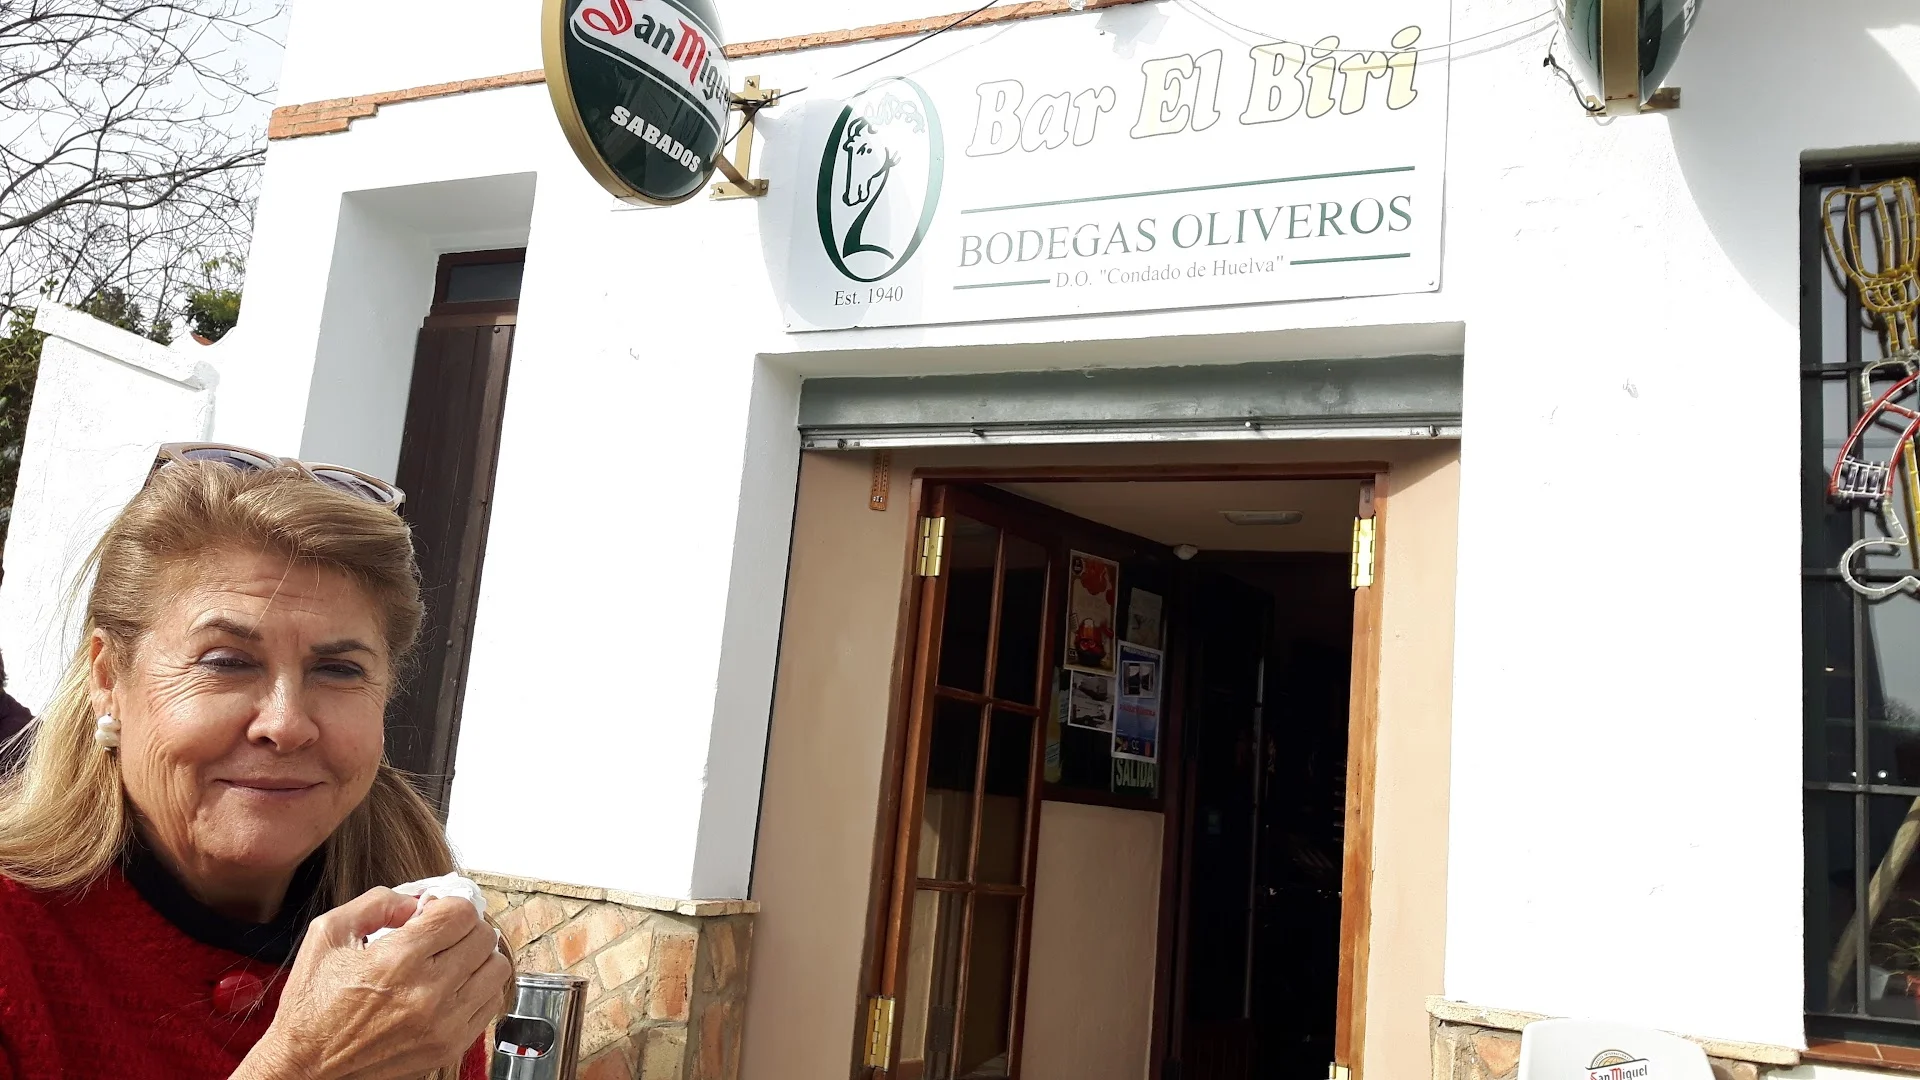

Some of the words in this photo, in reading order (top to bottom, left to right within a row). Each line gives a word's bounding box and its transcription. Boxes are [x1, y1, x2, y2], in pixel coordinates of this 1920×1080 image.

[582, 0, 676, 56] San
[965, 78, 1116, 158] Bar
[1129, 49, 1224, 141] El
[1240, 25, 1422, 126] Biri
[610, 105, 701, 173] SABADOS
[957, 217, 1158, 268] BODEGAS
[1171, 195, 1413, 250] OLIVEROS
[834, 290, 861, 306] Est.
[868, 285, 904, 304] 1940
[1056, 270, 1092, 288] D.O.
[1100, 263, 1181, 285] "Condado
[1186, 261, 1206, 278] de
[1212, 255, 1284, 277] Huelva"
[1115, 759, 1154, 788] SALIDA
